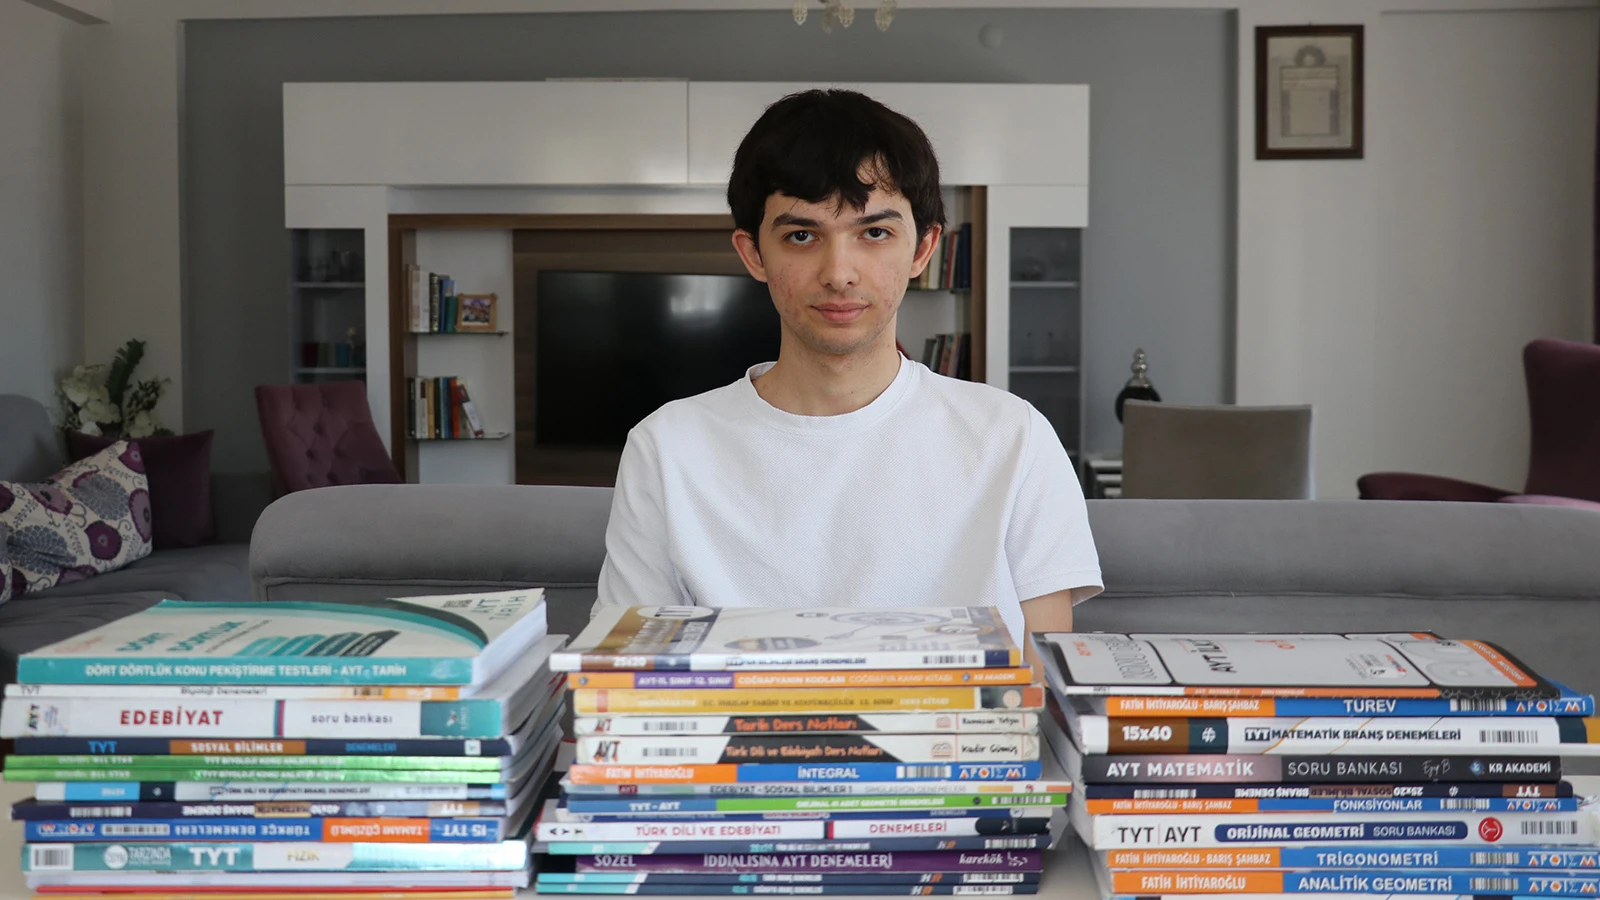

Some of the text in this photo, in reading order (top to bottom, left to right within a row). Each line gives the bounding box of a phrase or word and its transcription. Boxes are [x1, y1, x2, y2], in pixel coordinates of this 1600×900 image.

[85, 663, 407, 679] DÖRT DÖRTLÜK KONU PEKİŞTİRME TESTLERİ AYT TARİH
[1120, 697, 1144, 710] FATİH
[1146, 696, 1199, 710] İHTİYAROĞLU
[1203, 699, 1228, 713] BARIŞ
[1228, 698, 1260, 713] ŞAHBAZ
[120, 706, 393, 726] EDEBİYAT soru bankası
[734, 716, 858, 732] Tarih Ders Notları
[1122, 725, 1173, 741] 15x40
[1245, 726, 1462, 741] TYT MATEMATİK BRANŞ DENEMELERİ
[88, 740, 118, 753] TYT
[191, 742, 231, 754] SOSYAL
[234, 739, 284, 754] BİLİMLER
[593, 740, 621, 762] AYT
[726, 746, 747, 757] Türk
[750, 746, 765, 757] Dili
[767, 748, 778, 757] ve
[825, 747, 845, 756] Ders
[848, 745, 883, 757] Notları
[606, 767, 632, 779] FATİH
[634, 765, 695, 779] İHTİYAROĞLU
[797, 766, 860, 779] İNTEGRAL
[1106, 758, 1403, 777] AYT MATEMATİK SORU BANKASI
[1488, 761, 1551, 773] KR AKADEMİ
[709, 785, 755, 794] EDEBİYAT
[764, 785, 800, 794] SOSYAL
[803, 785, 846, 794] BİLİMLER
[1235, 785, 1541, 798] TYT 25x20 SOSYAL BİLİMLER BRANŞ DENEME
[181, 804, 222, 816] DENEME
[222, 803, 255, 815] BRANŞ
[441, 804, 464, 814] TYT
[629, 801, 681, 811] TYT AYT
[1112, 800, 1133, 810] FATİH
[1182, 800, 1204, 812] BARIŞ
[1205, 800, 1232, 812] ŞAHBAZ
[1333, 797, 1423, 811] FONKSİYONLAR
[175, 824, 256, 837] DENEMELERİ
[260, 823, 311, 837] TÜRKÇE
[331, 823, 381, 837] ÇÖZÜMLÜ
[383, 825, 423, 836] TAMAMI
[442, 824, 468, 836] TYT
[635, 821, 948, 836] TÜRK DİLİ VE EDEBİYATI DENEMELERİ
[1118, 823, 1456, 843] TYT AYT ORİJİNAL GEOMETRİ SORU BANKASI
[189, 847, 240, 866] TYT
[703, 852, 780, 867] İDDİALISINA
[781, 855, 807, 867] AYT
[810, 852, 893, 869] DENEMELERİ
[959, 852, 1003, 865] karekök
[1115, 852, 1140, 865] FATİH
[1143, 852, 1200, 865] İHTİYAROĞLU
[1206, 853, 1233, 867] BARIŞ
[1236, 853, 1271, 867] ŞAHBAZ
[1317, 850, 1439, 867] TRİGONOMETRİ
[1141, 875, 1171, 890] FATİH
[1176, 874, 1247, 890] İHTİYAROĞLU
[1298, 876, 1369, 892] ANALİTİK
[1372, 875, 1453, 892] GEOMETRİ
